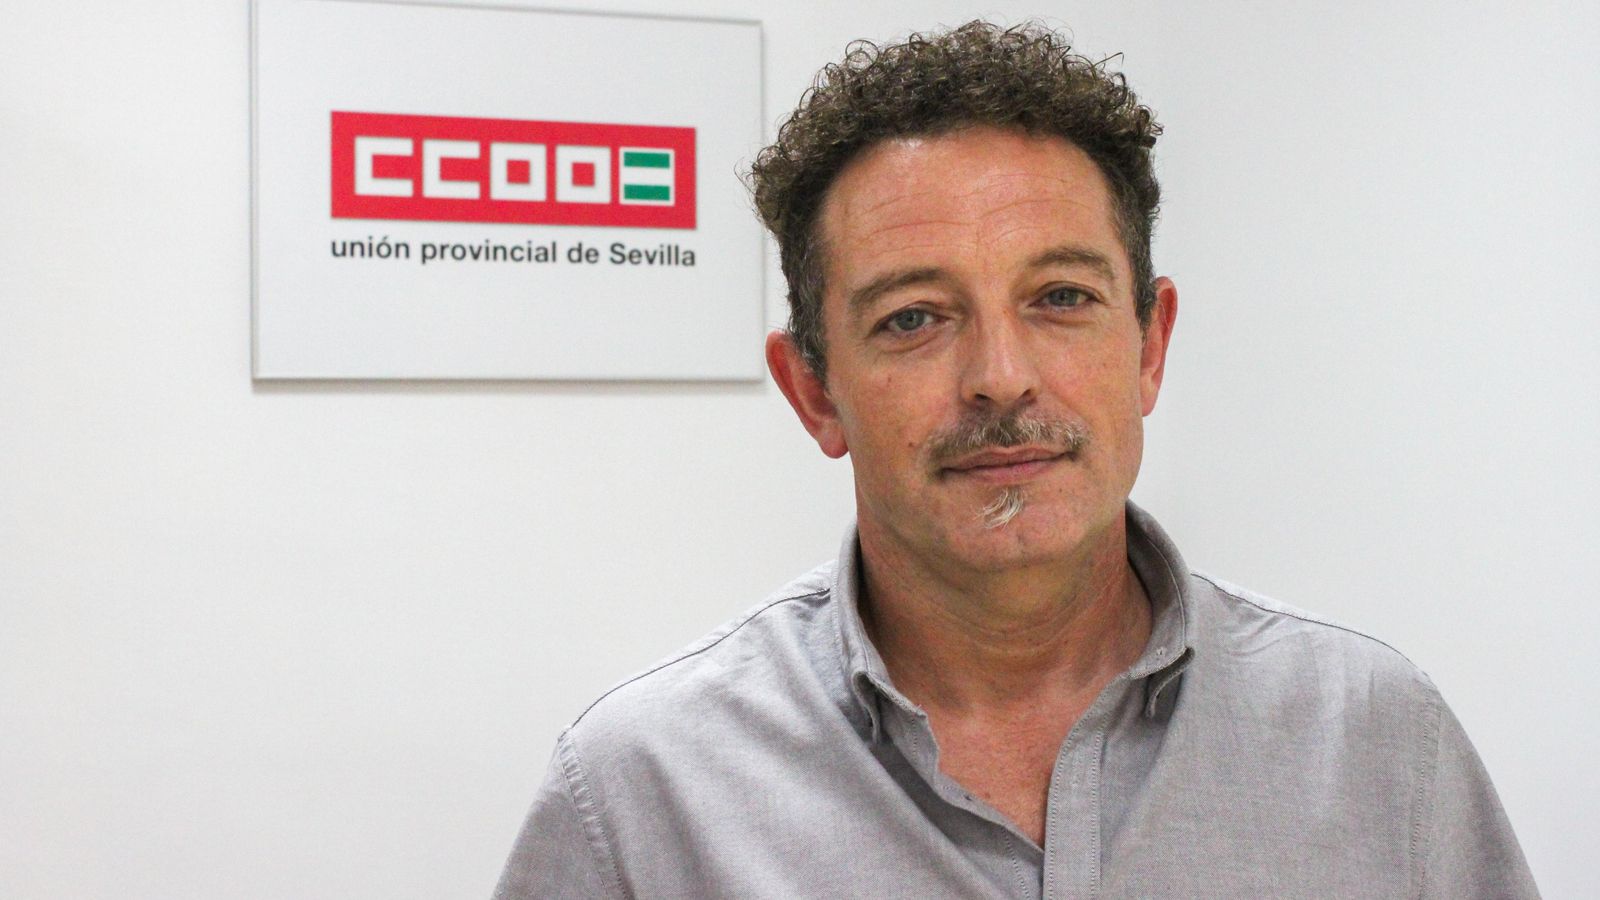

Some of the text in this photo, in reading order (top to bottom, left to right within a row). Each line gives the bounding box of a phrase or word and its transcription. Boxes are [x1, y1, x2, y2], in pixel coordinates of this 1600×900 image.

[354, 136, 612, 204] CCOO
[331, 236, 696, 266] unión provincial de Sevilla
